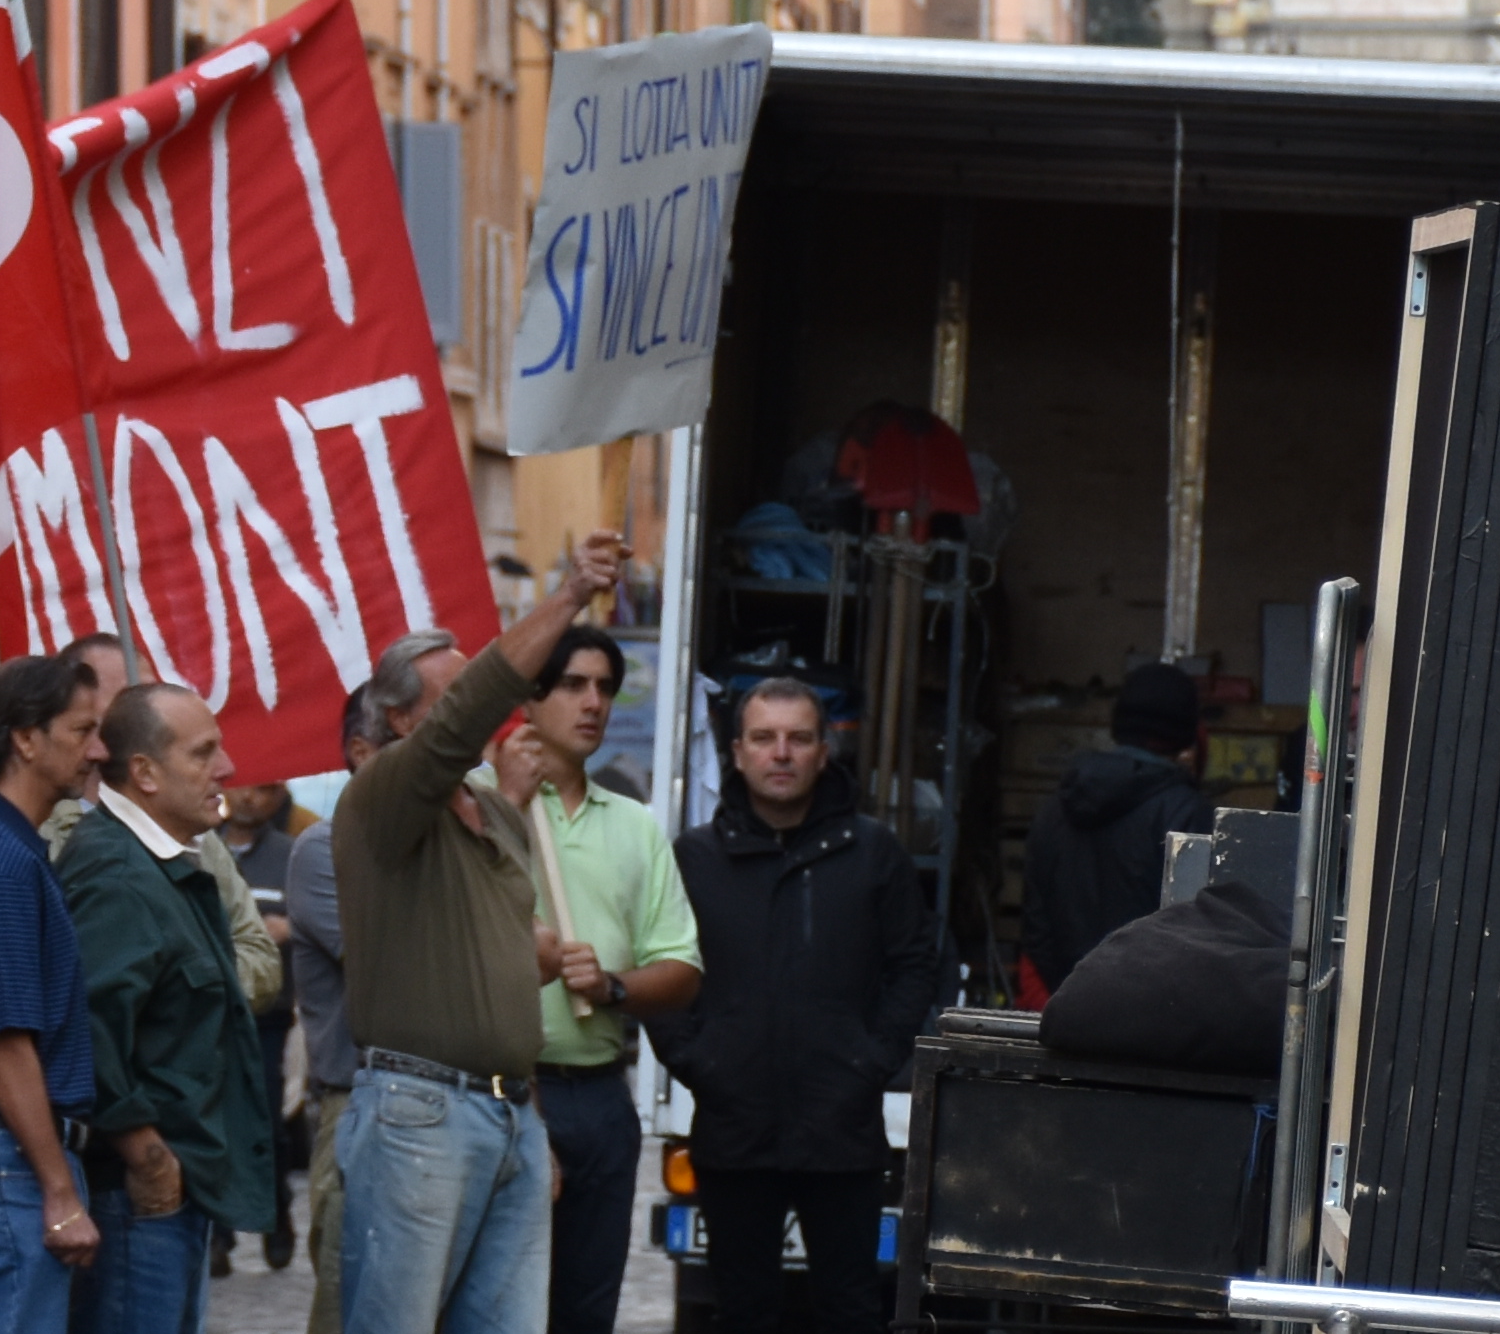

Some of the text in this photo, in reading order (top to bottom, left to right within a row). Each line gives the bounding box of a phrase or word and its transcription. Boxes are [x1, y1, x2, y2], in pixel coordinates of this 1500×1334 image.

[564, 95, 600, 174] SI
[620, 72, 690, 165] LOTTA
[520, 213, 591, 377] SI
